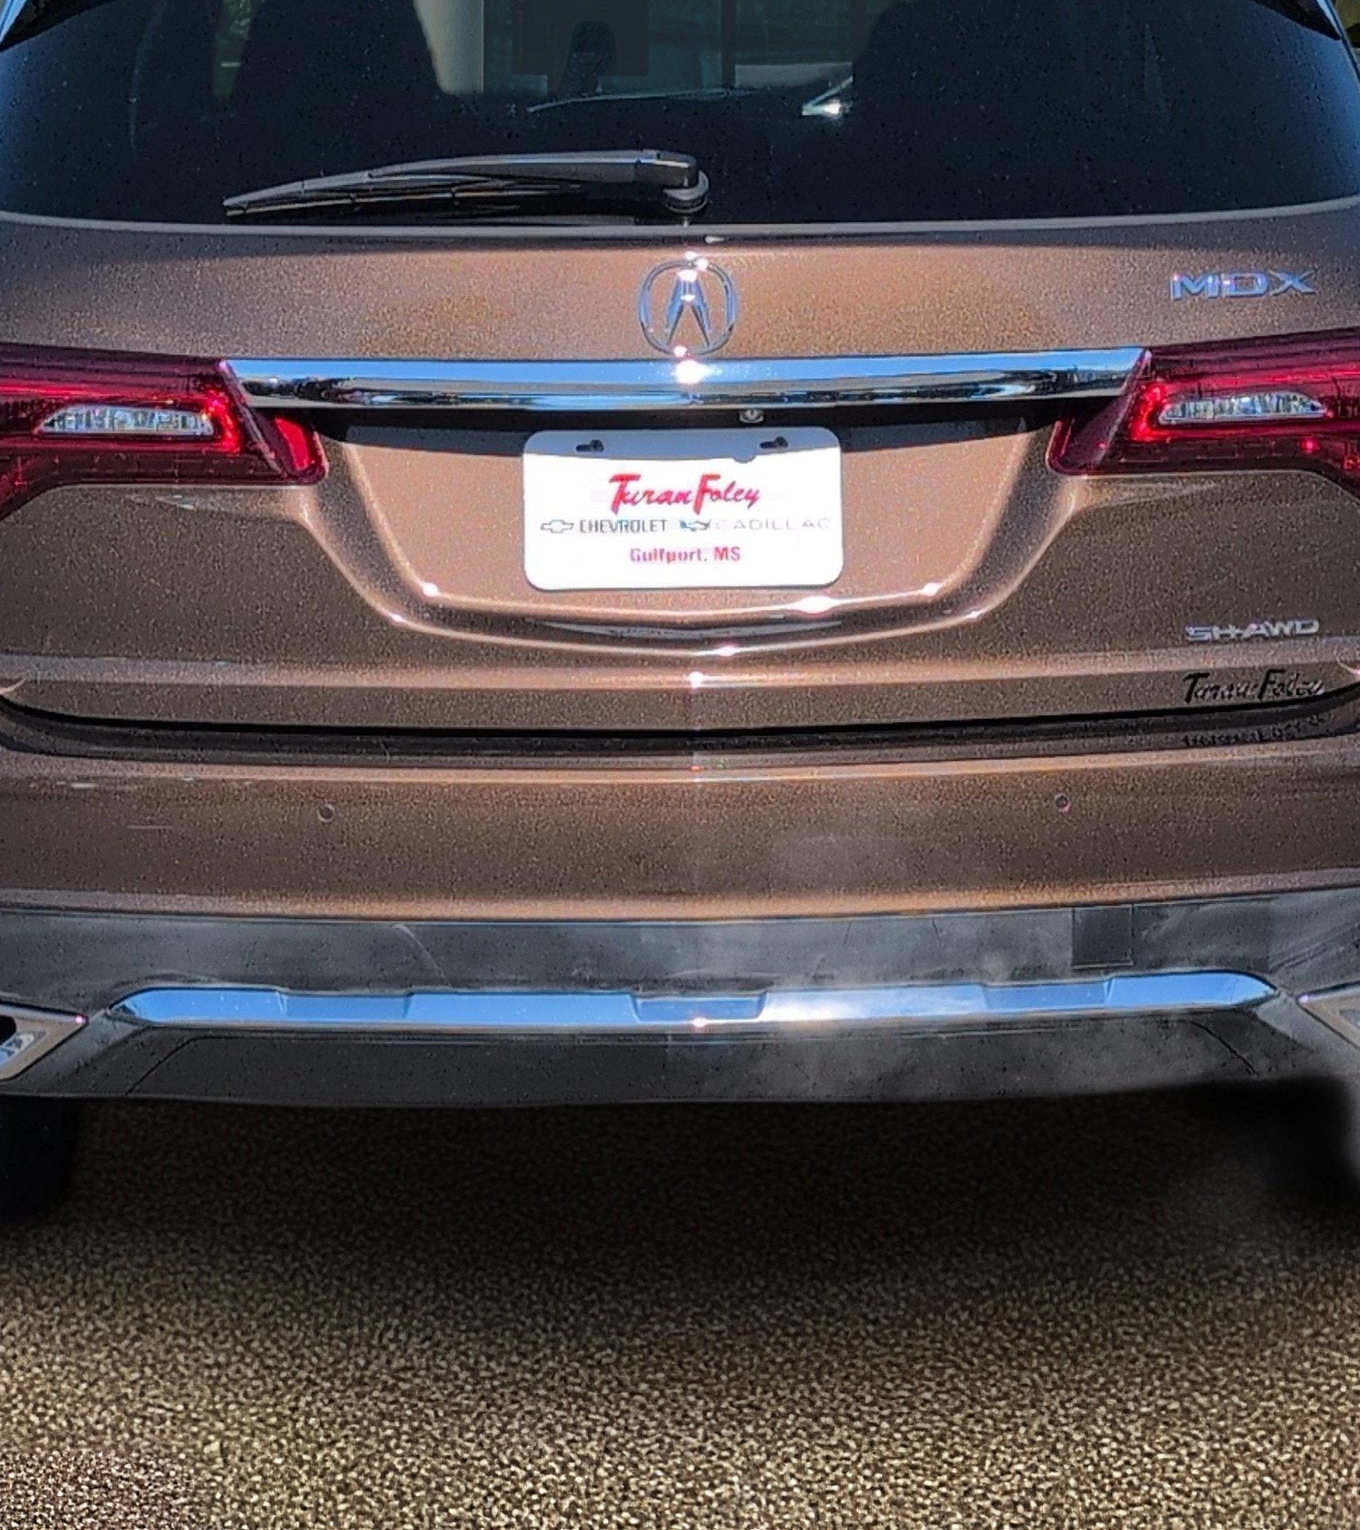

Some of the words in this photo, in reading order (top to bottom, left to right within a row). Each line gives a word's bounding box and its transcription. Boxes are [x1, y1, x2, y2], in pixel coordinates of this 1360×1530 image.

[1169, 270, 1317, 301] MDX
[579, 519, 668, 534] CHEVROLET
[714, 546, 741, 561] MS
